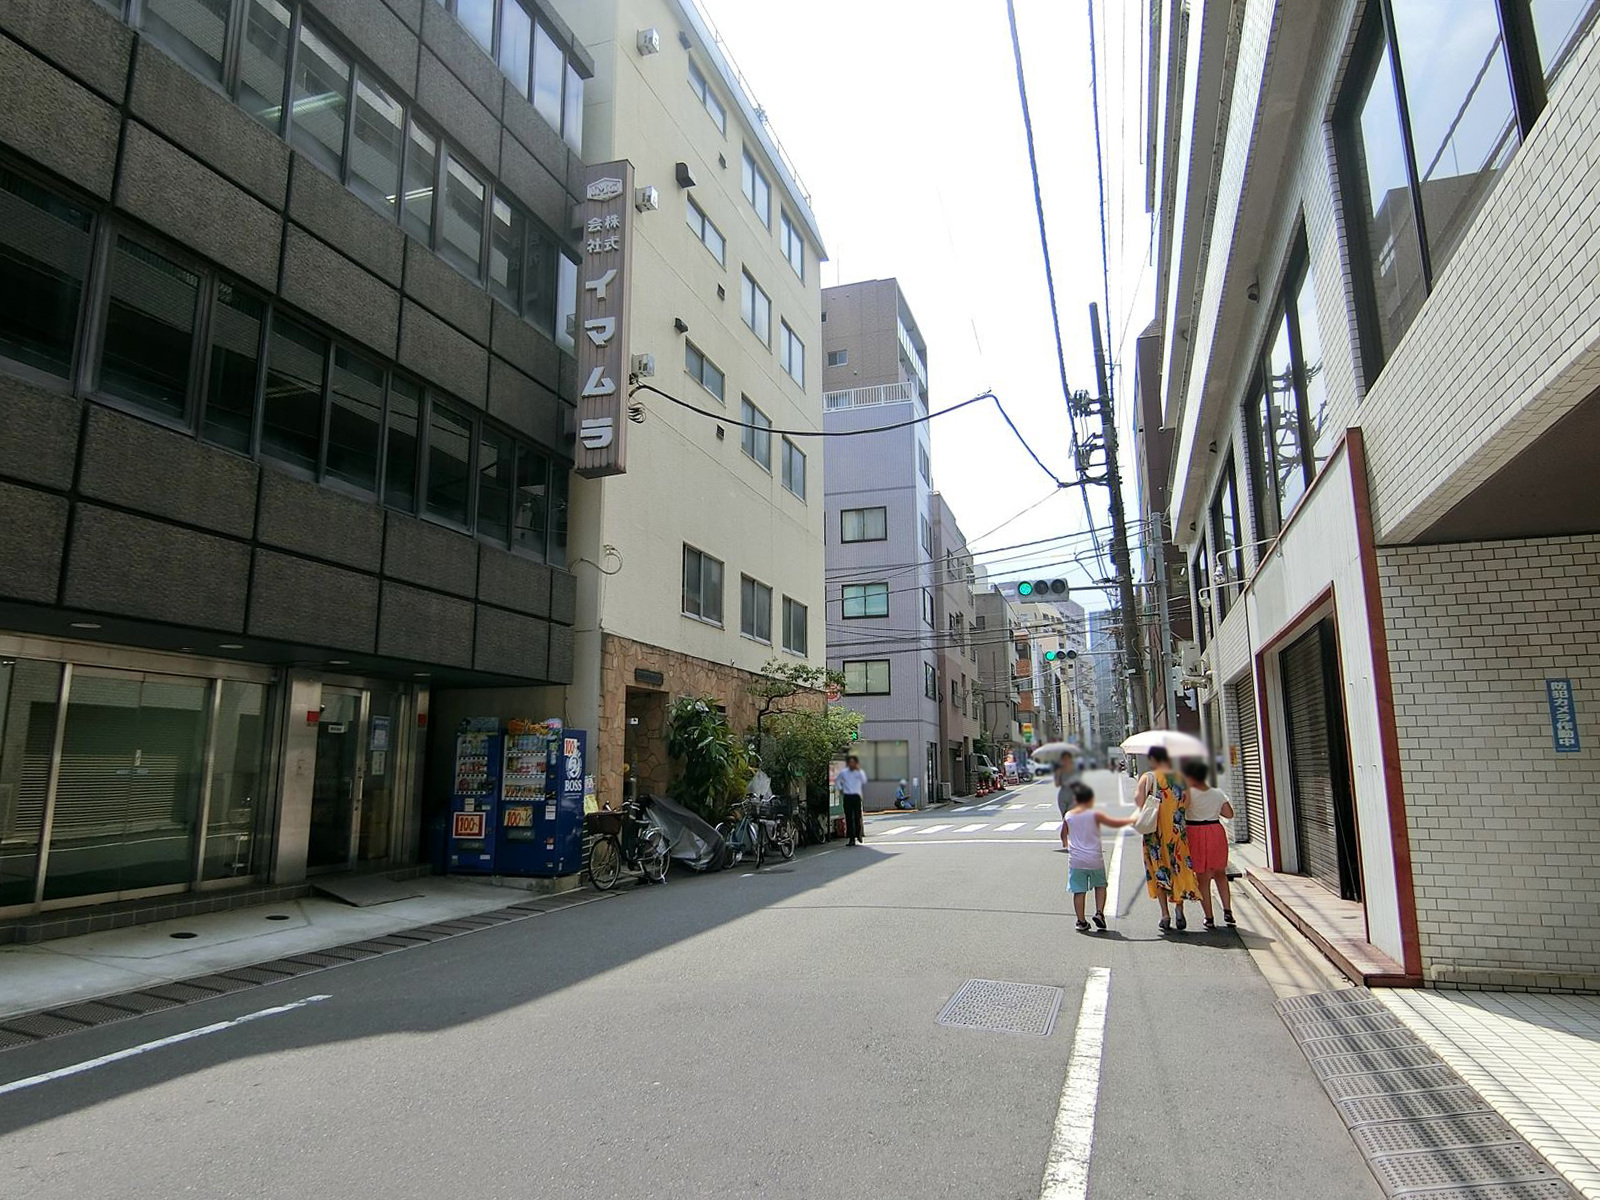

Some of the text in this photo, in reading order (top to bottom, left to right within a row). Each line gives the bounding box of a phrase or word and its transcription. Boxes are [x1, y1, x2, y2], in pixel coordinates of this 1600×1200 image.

[580, 269, 618, 449] イマムラ
[1550, 682, 1575, 746] 防犯カメラ作動中
[564, 779, 583, 792] BOSS
